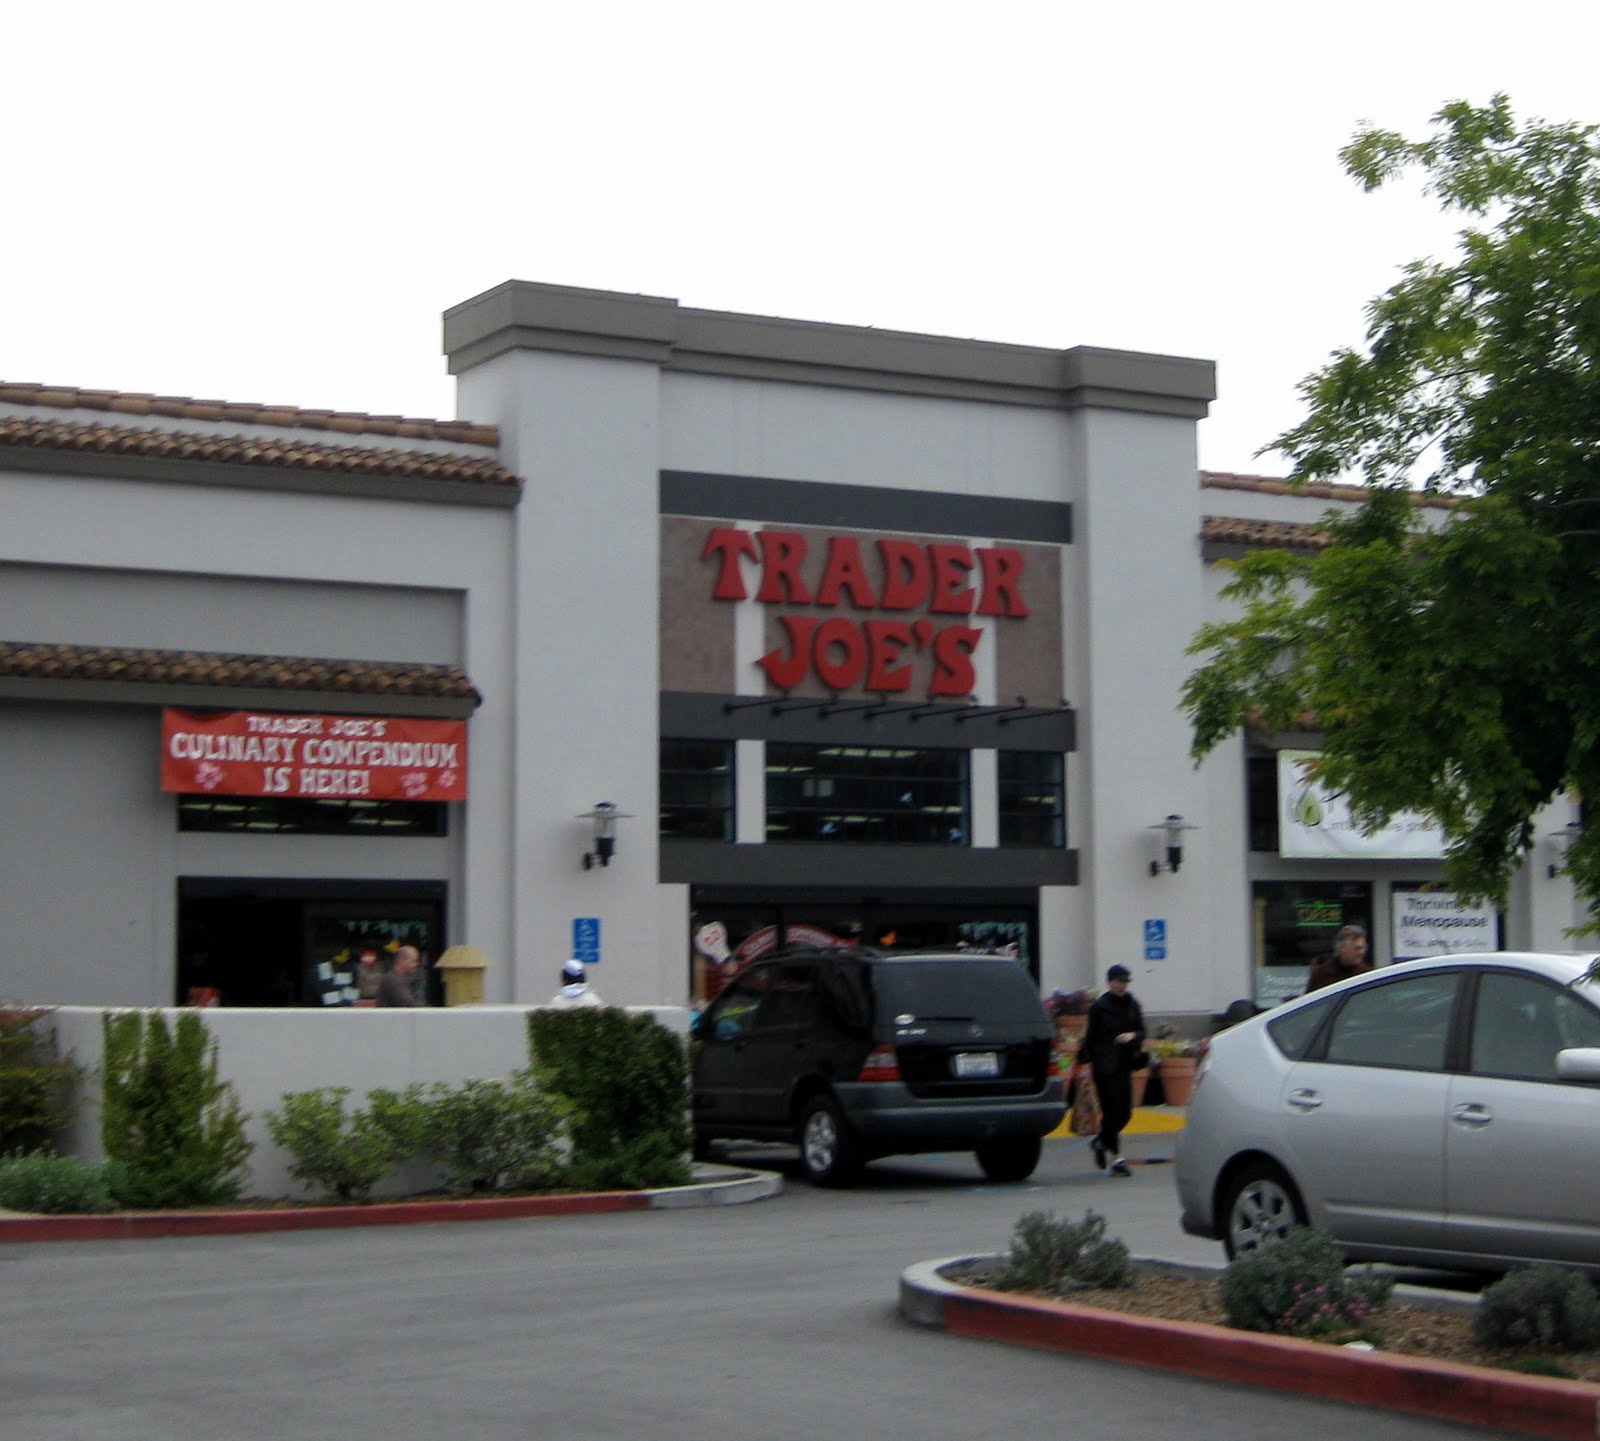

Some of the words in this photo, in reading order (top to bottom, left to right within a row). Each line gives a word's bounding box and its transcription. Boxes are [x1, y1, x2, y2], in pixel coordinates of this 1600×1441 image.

[701, 527, 1030, 618] TRADER
[755, 616, 985, 696] JOE'S
[246, 716, 324, 734] TRADER
[329, 720, 388, 737] JOE'S
[170, 733, 298, 763] CULINARY
[302, 739, 459, 768] COMPENDIUM
[263, 767, 293, 793] IS
[299, 769, 371, 795] HERE!
[1401, 915, 1489, 931] Menopause
